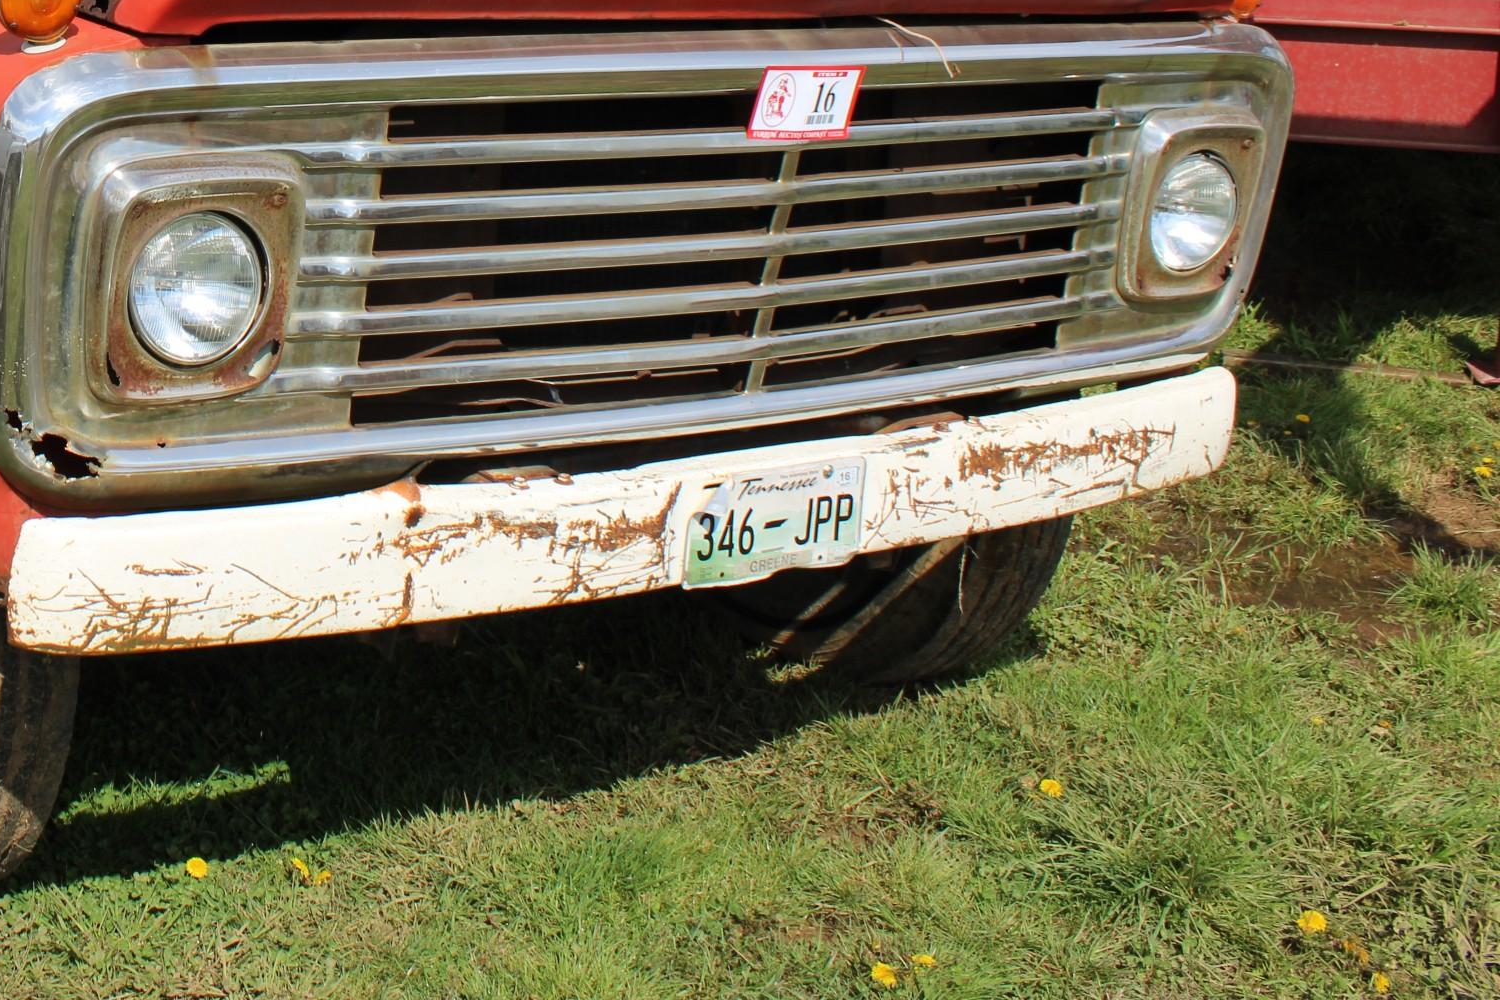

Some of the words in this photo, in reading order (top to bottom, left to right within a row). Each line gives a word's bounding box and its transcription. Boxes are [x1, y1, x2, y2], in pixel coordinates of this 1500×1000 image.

[811, 81, 840, 113] 16
[738, 477, 817, 501] Tennessee
[750, 553, 797, 573] GREENE
